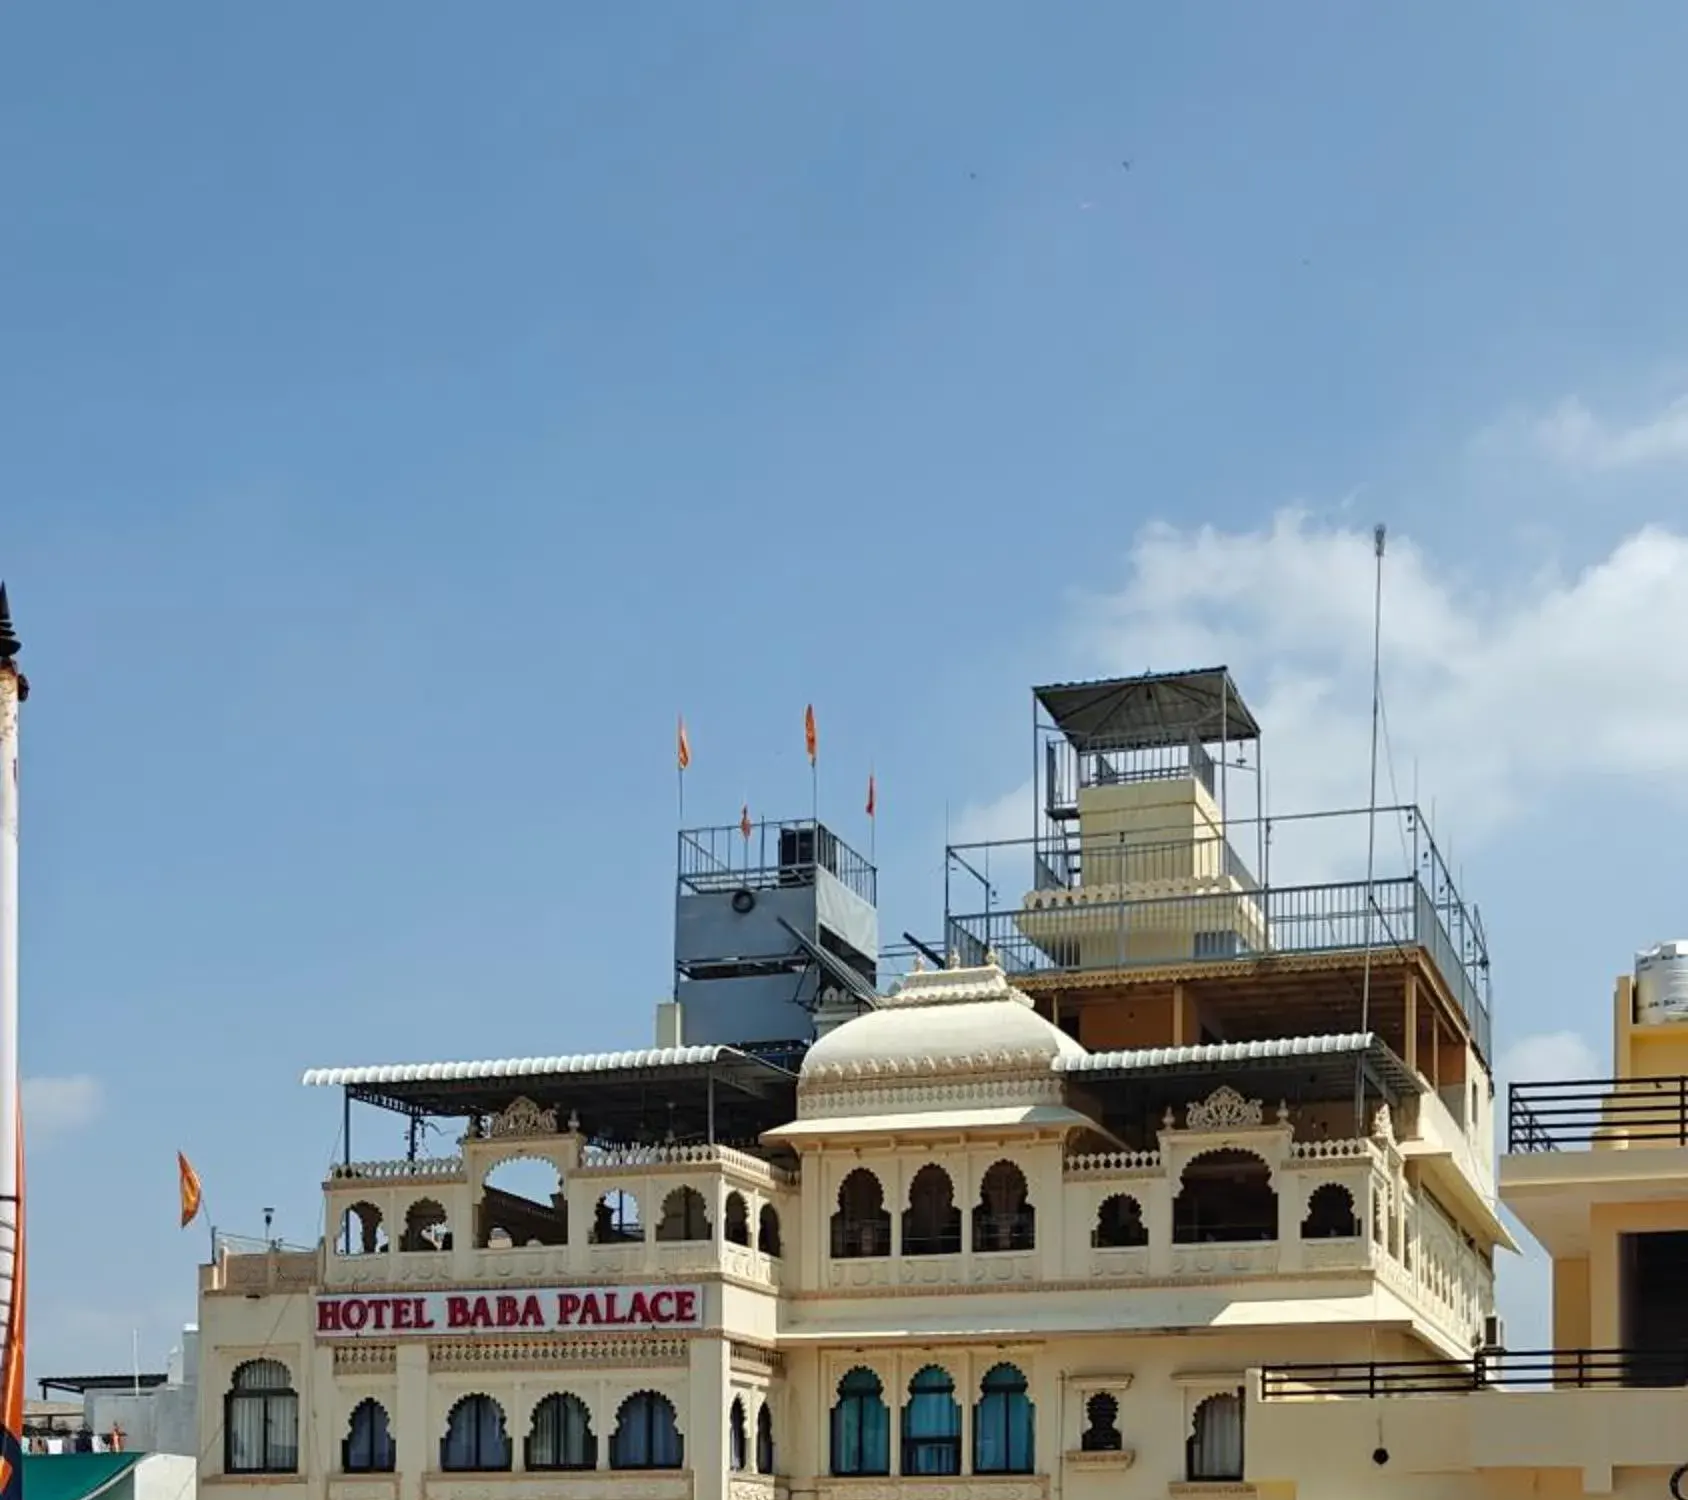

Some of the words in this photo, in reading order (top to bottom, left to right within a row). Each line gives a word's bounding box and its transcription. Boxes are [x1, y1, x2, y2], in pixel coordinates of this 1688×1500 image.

[317, 1297, 435, 1331] HOTEL
[445, 1294, 546, 1328] BABA
[557, 1290, 697, 1325] PALACE
